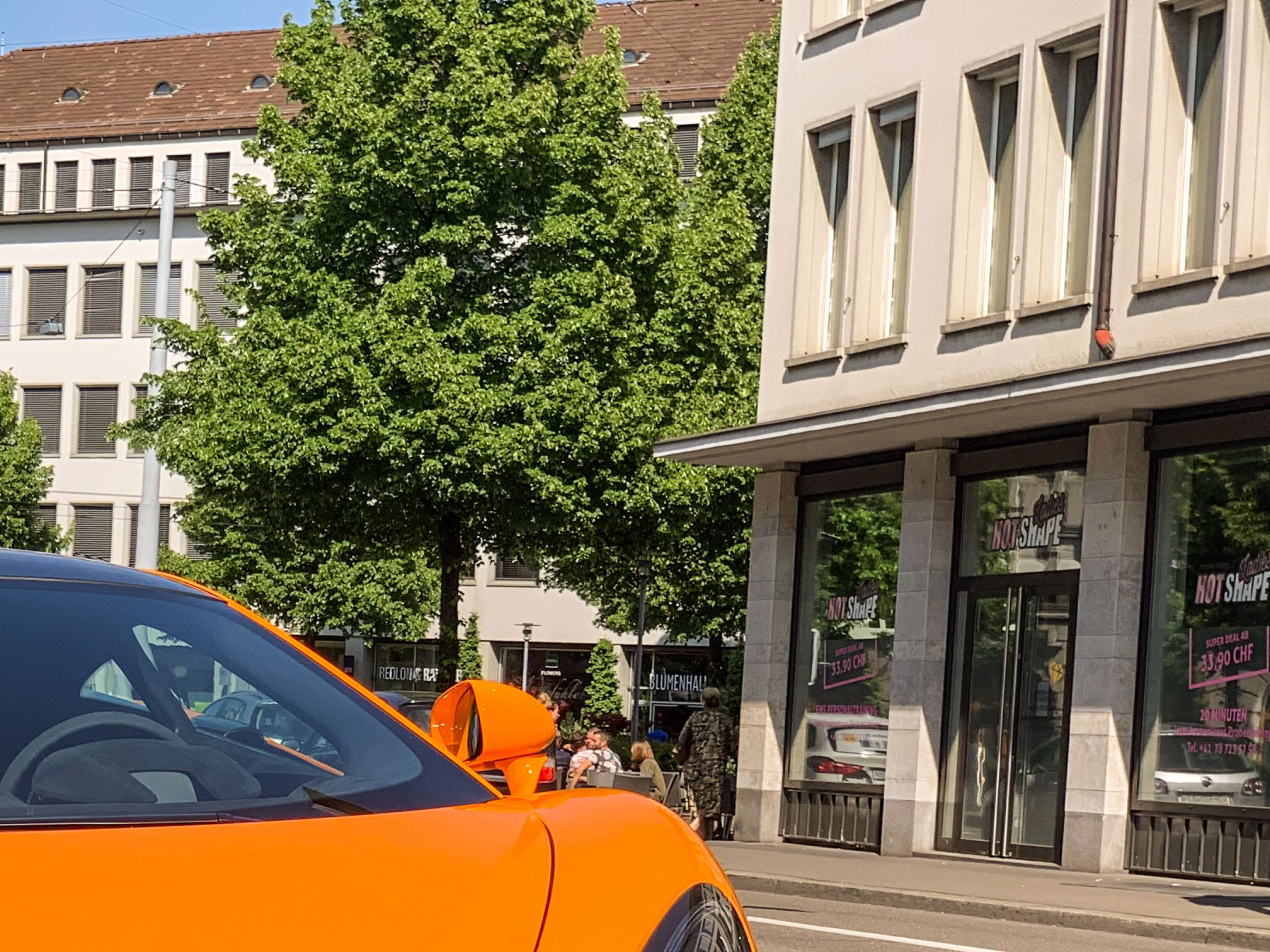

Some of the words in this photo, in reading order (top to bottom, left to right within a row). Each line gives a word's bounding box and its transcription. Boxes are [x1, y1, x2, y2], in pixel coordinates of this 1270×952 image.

[992, 517, 1020, 550] HOT
[1018, 513, 1064, 549] SHAPE
[1195, 573, 1225, 604] HOT
[1224, 570, 1270, 603] SHAPE
[827, 597, 848, 620] HOT
[1205, 636, 1224, 648] SUPER
[1225, 633, 1240, 644] DEAL
[1241, 630, 1249, 640] AB
[1233, 643, 1254, 664] CHF
[1200, 709, 1210, 721] 20
[1211, 708, 1248, 723] MINUTEN
